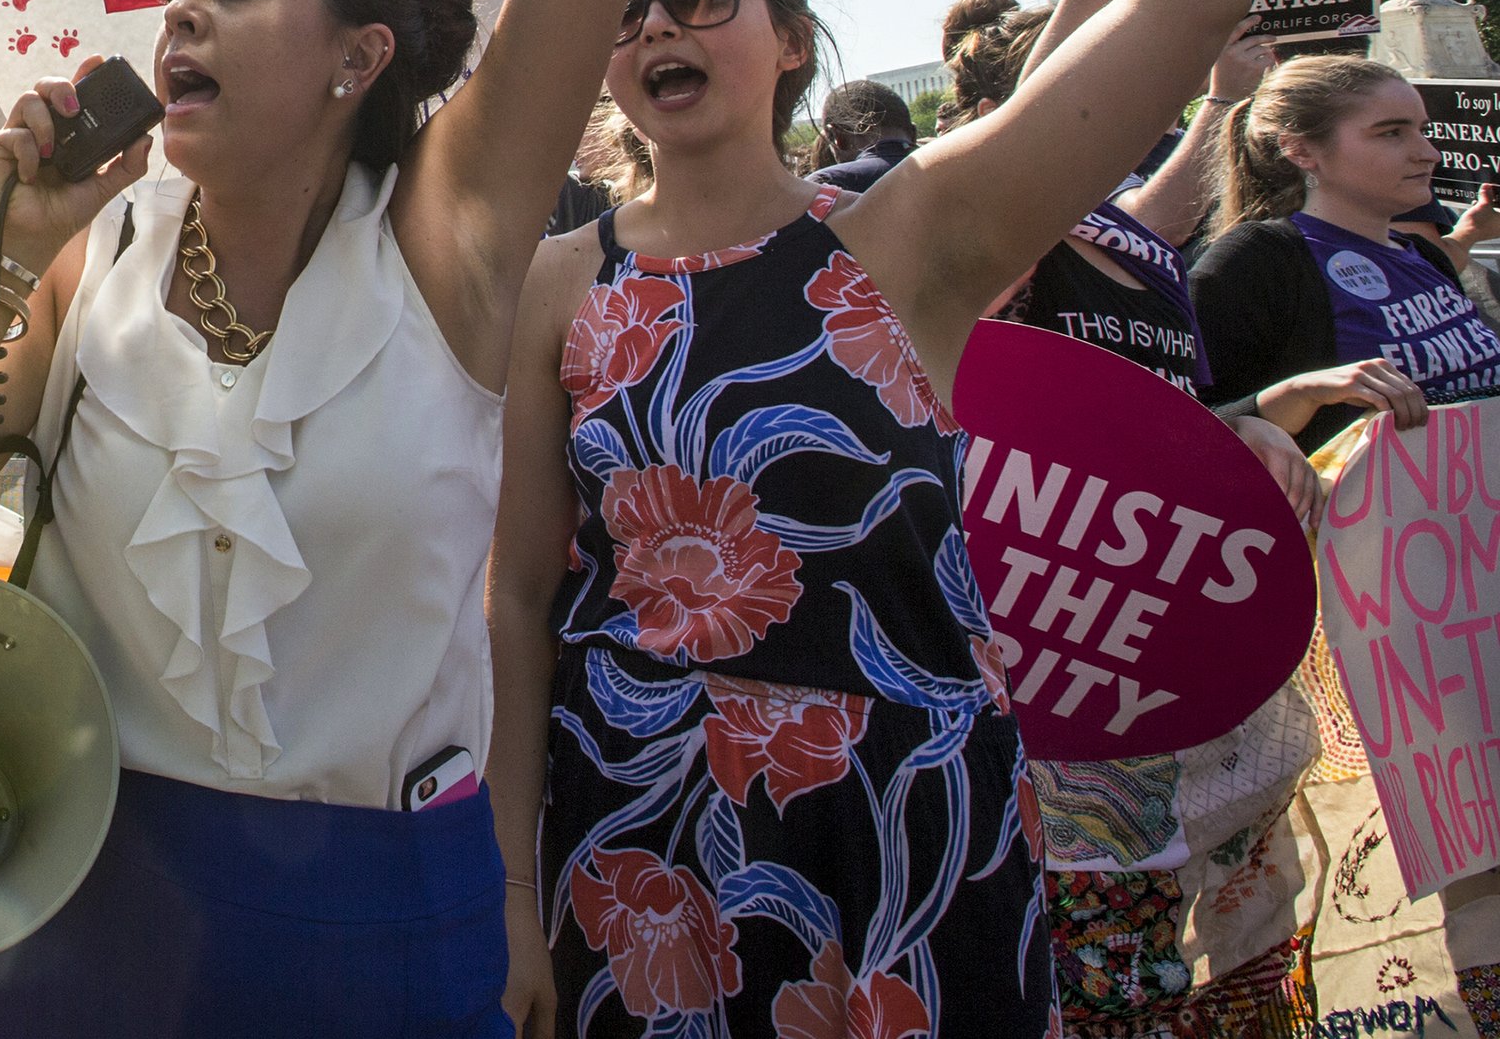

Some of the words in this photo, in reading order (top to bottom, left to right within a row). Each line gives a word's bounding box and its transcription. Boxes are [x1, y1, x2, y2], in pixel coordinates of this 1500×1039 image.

[1455, 91, 1471, 109] Yo
[1473, 98, 1491, 117] soy
[1057, 313, 1122, 343] THIS
[1128, 319, 1150, 348] IS
[989, 546, 1170, 663] THE
